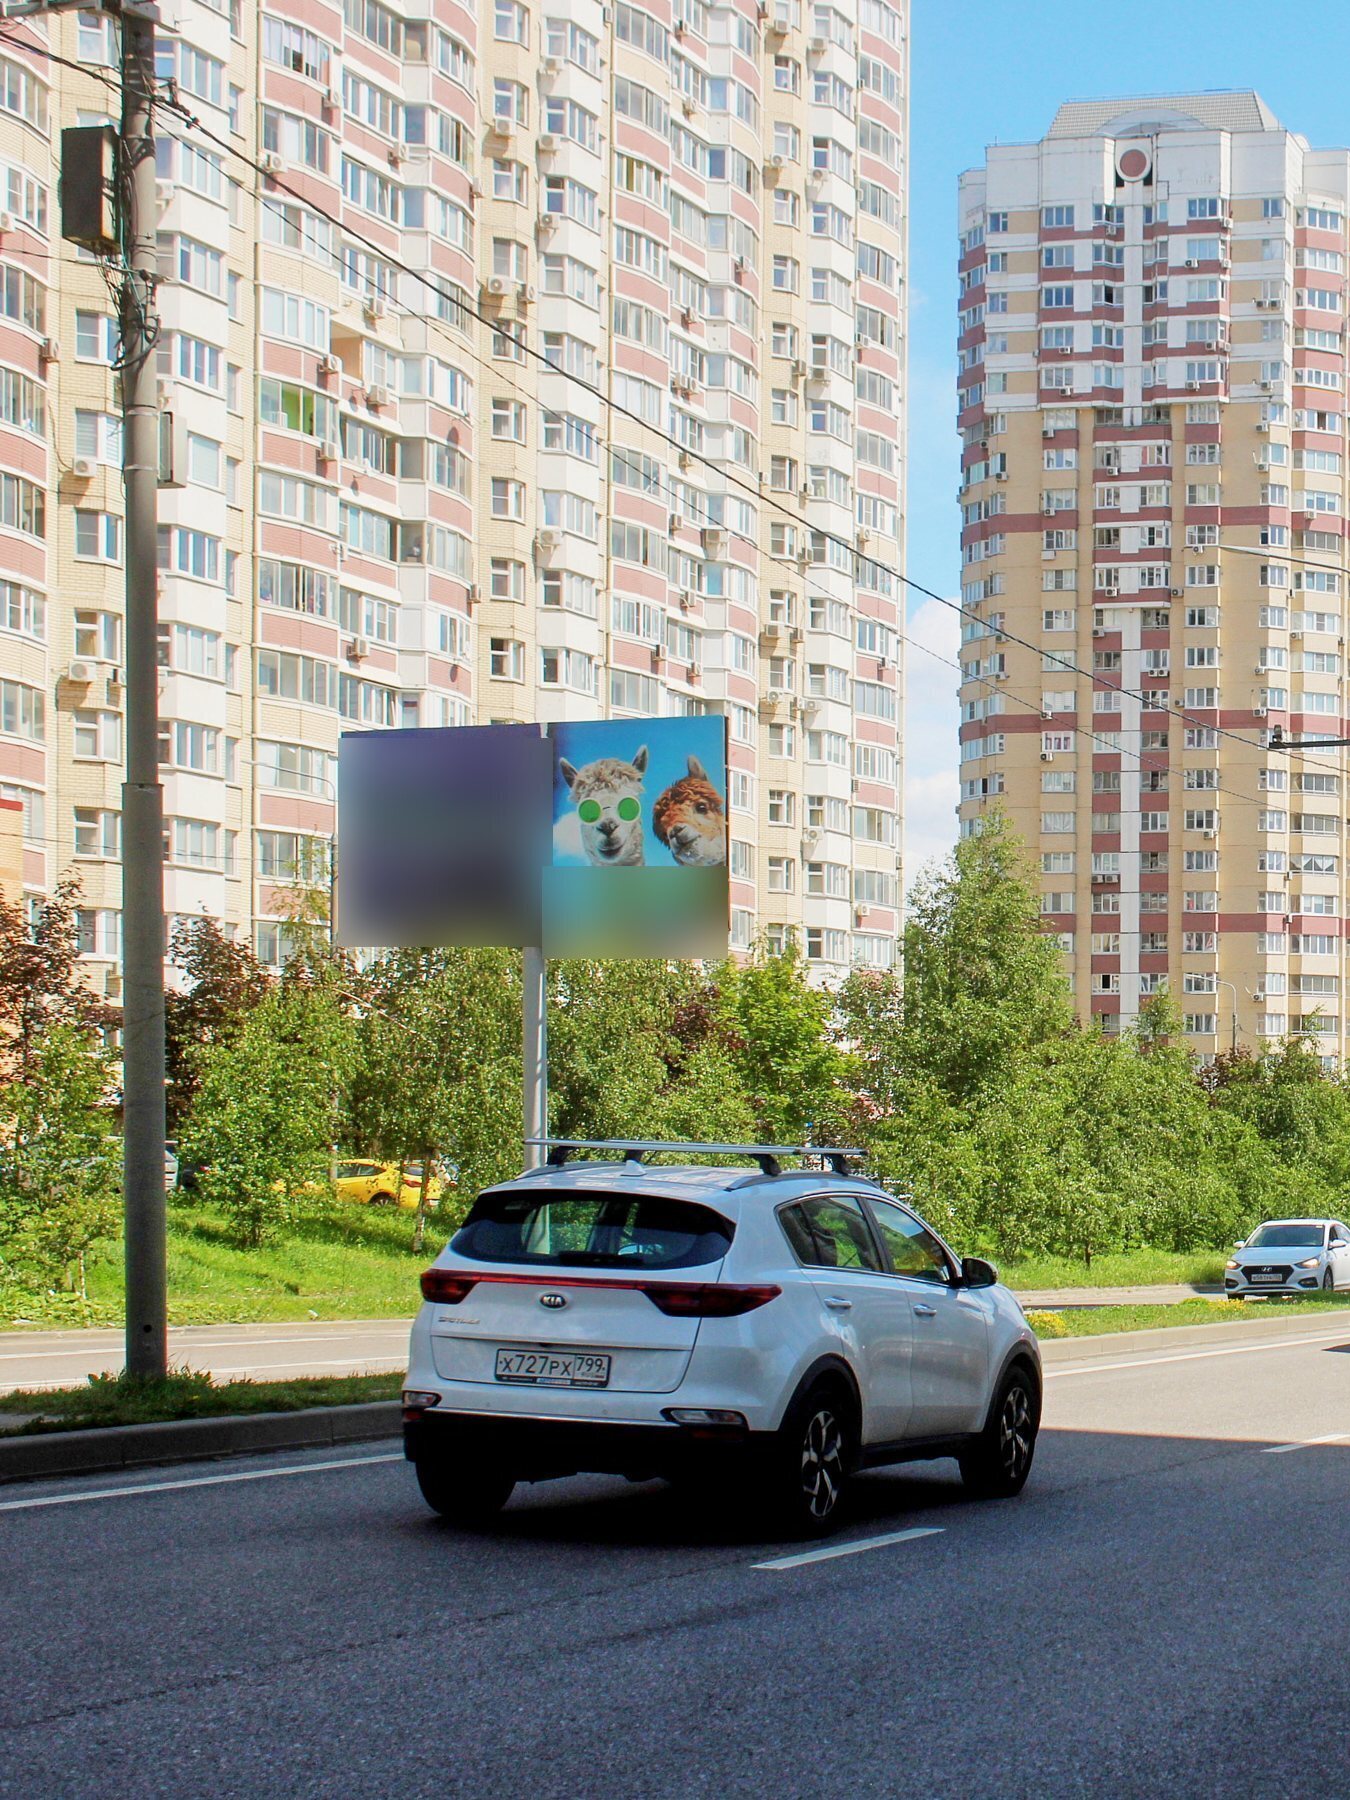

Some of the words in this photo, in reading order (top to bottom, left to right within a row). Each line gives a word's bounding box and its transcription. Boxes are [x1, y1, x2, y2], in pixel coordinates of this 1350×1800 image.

[543, 1296, 562, 1305] KIA
[502, 1354, 573, 1377] Х727РХ
[577, 1357, 604, 1372] 799
